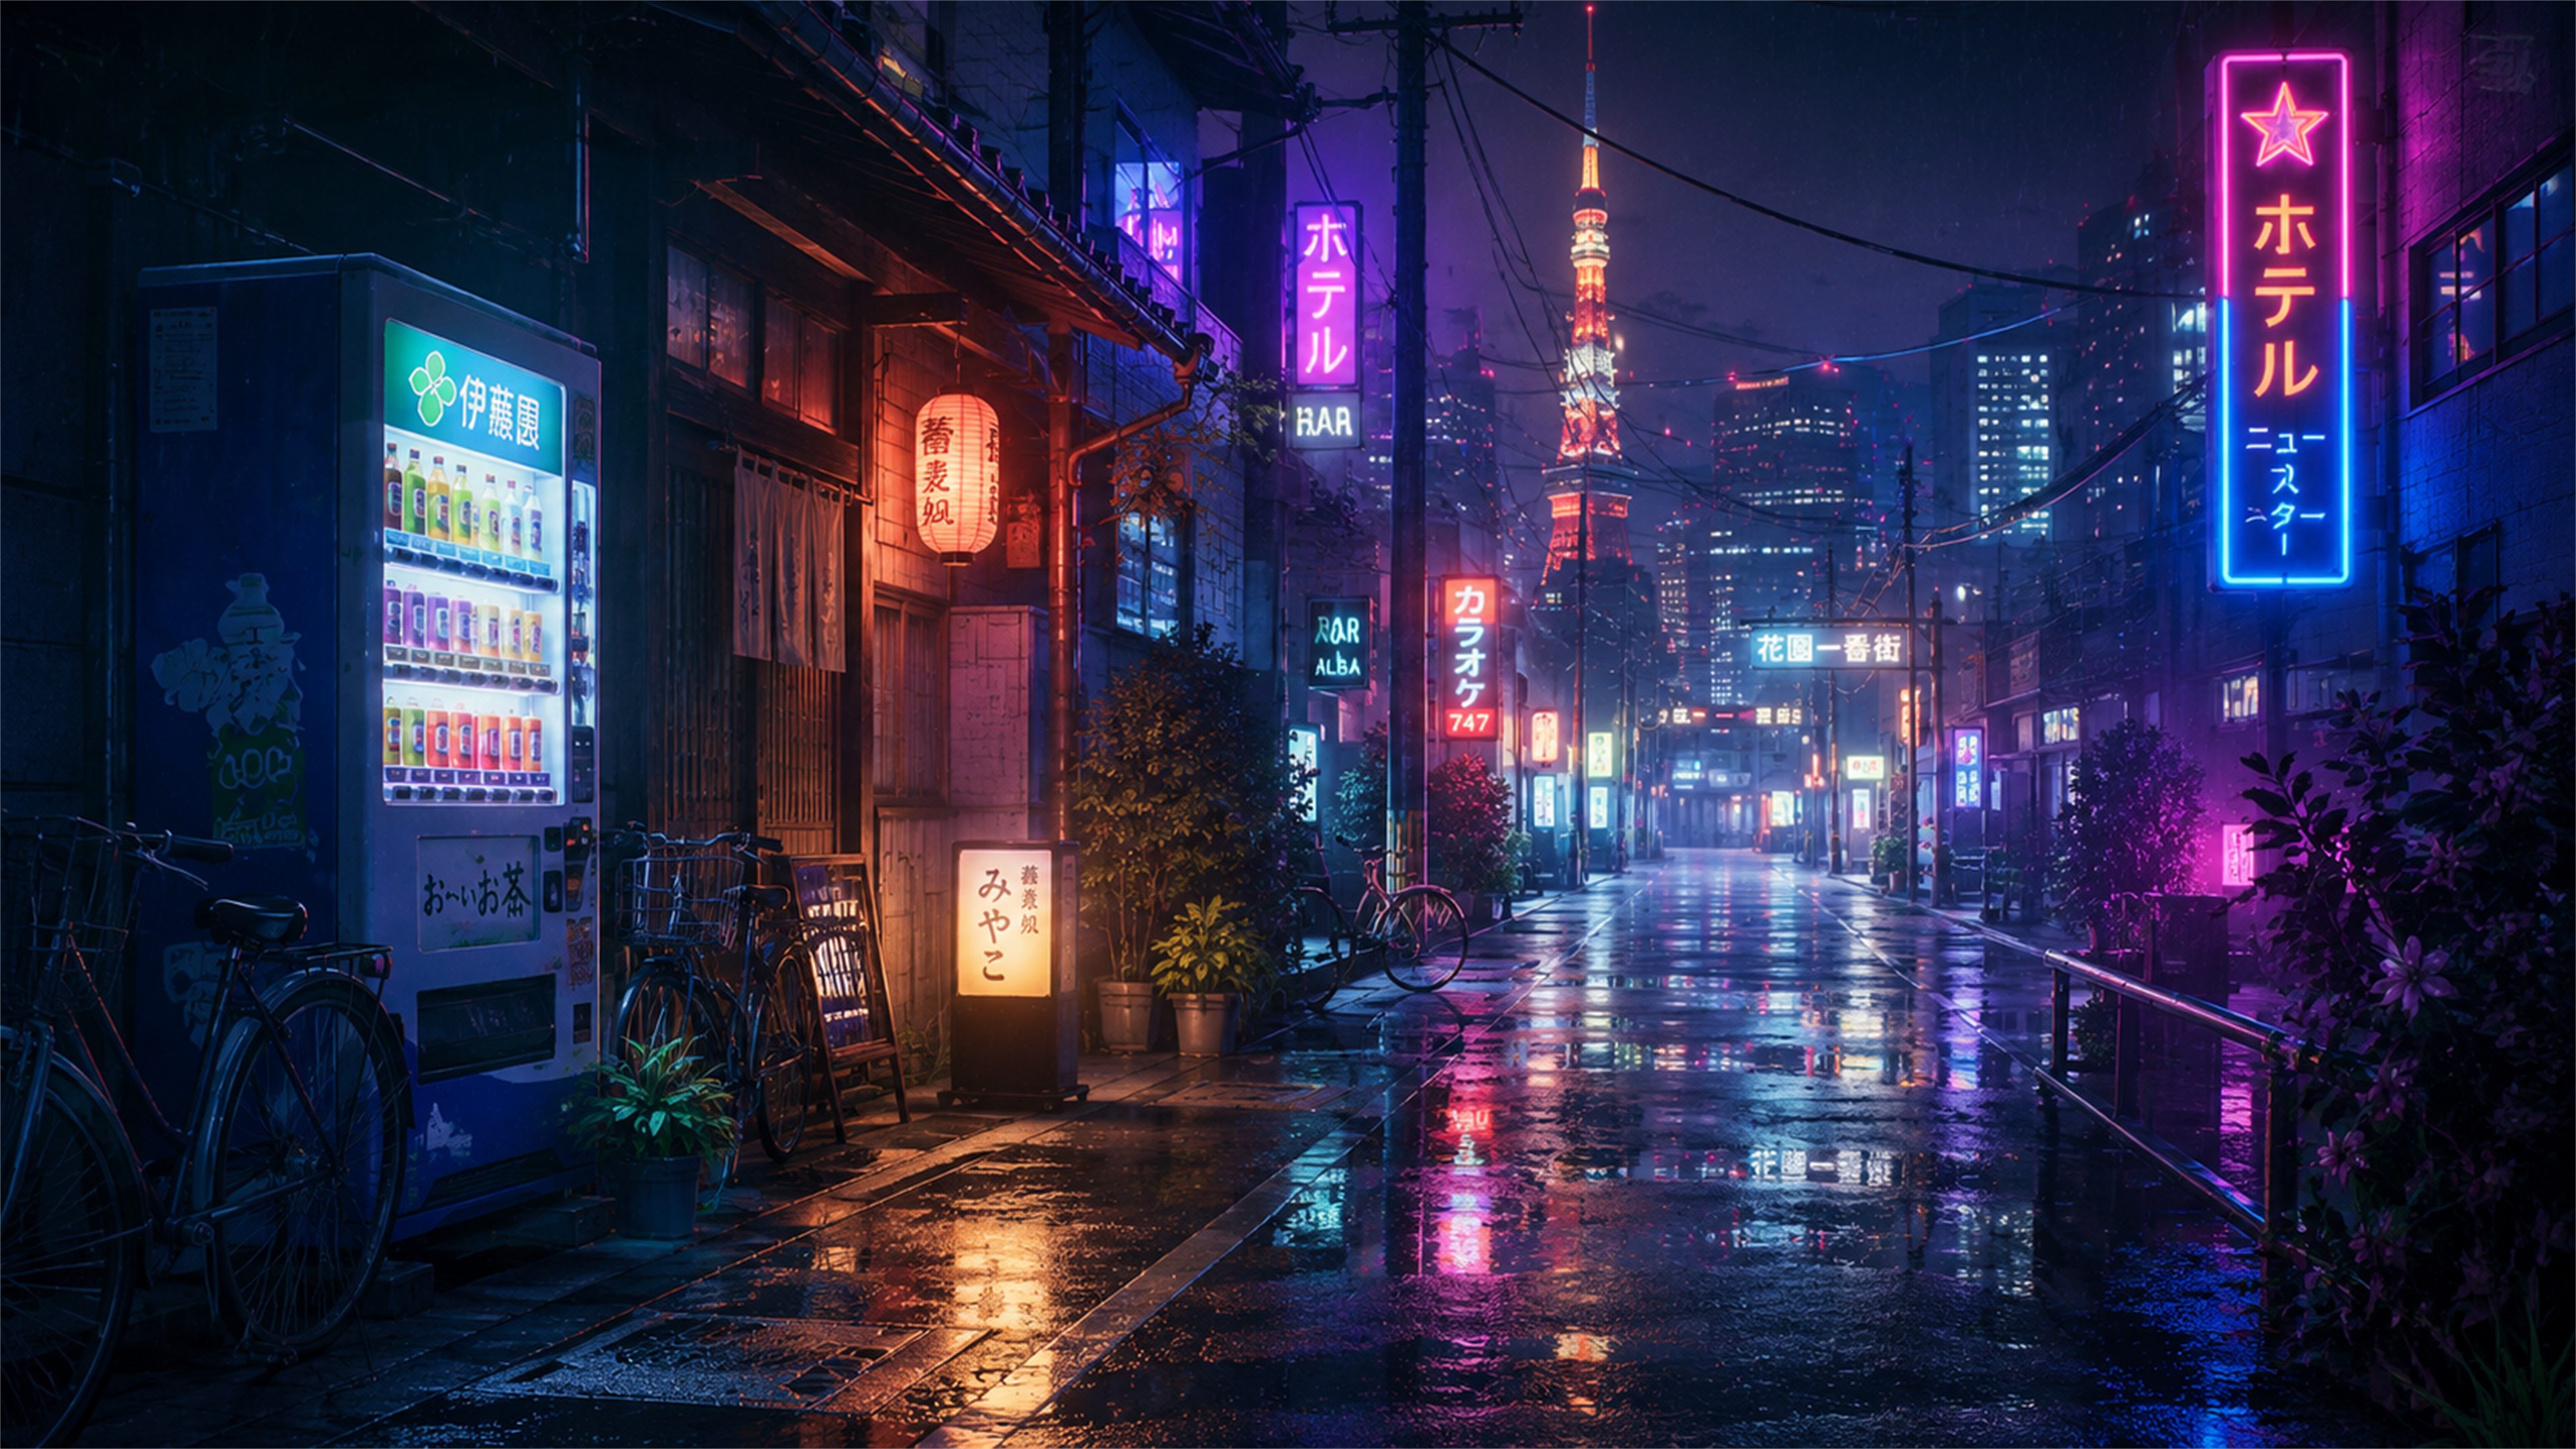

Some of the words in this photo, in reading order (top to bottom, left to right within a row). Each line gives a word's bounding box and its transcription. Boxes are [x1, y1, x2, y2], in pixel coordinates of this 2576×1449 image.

[1304, 213, 1348, 374] ホテル
[2253, 194, 2318, 398] ホテル
[1454, 584, 1486, 708] カラオケ
[1449, 713, 1490, 733] 747
[978, 869, 1012, 981] みやこ
